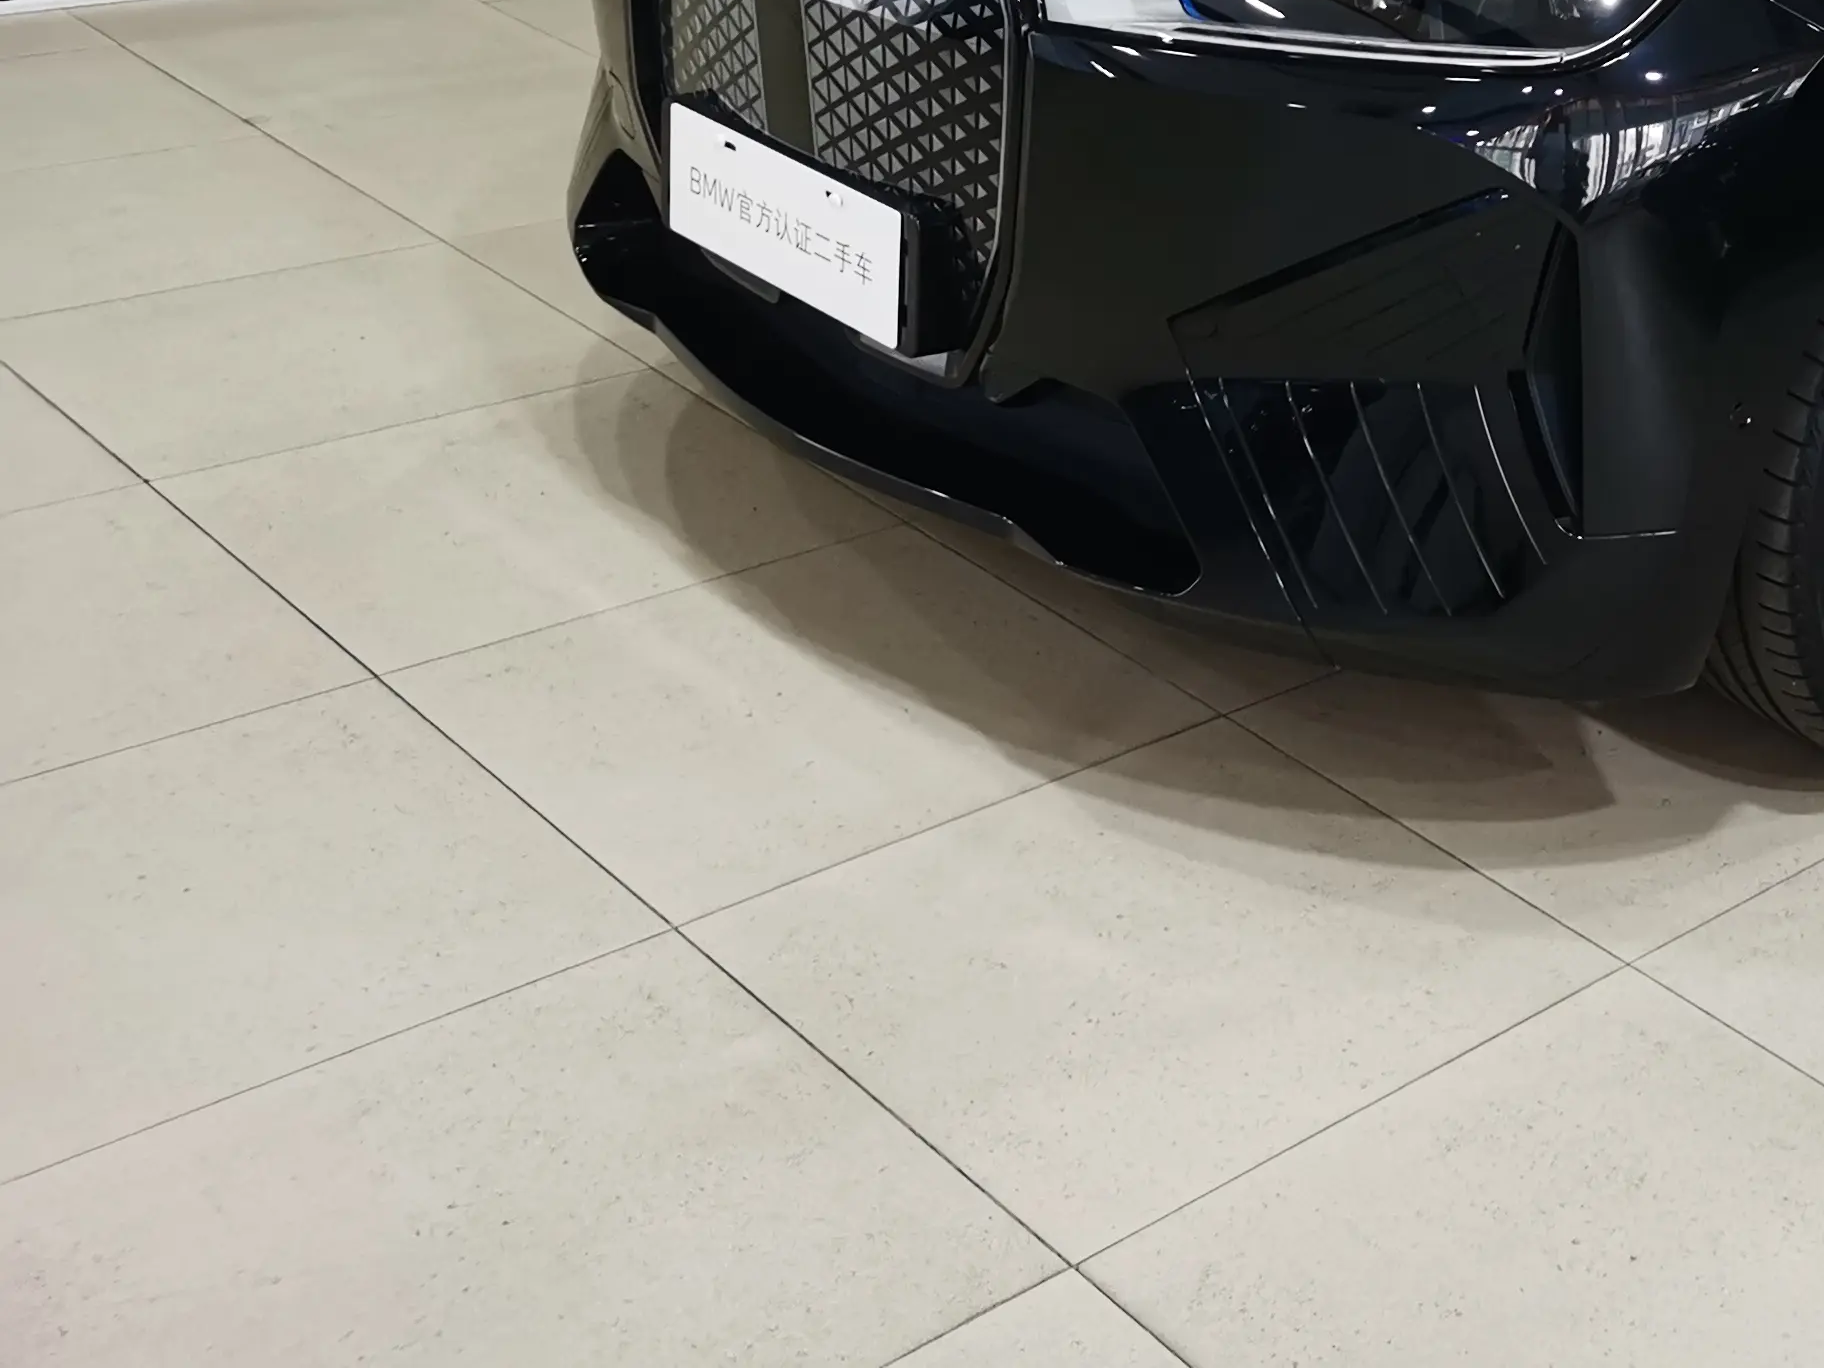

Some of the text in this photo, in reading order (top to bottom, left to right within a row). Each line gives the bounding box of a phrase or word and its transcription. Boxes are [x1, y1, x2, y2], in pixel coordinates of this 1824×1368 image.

[689, 166, 873, 285] BMW官方认证二手车
